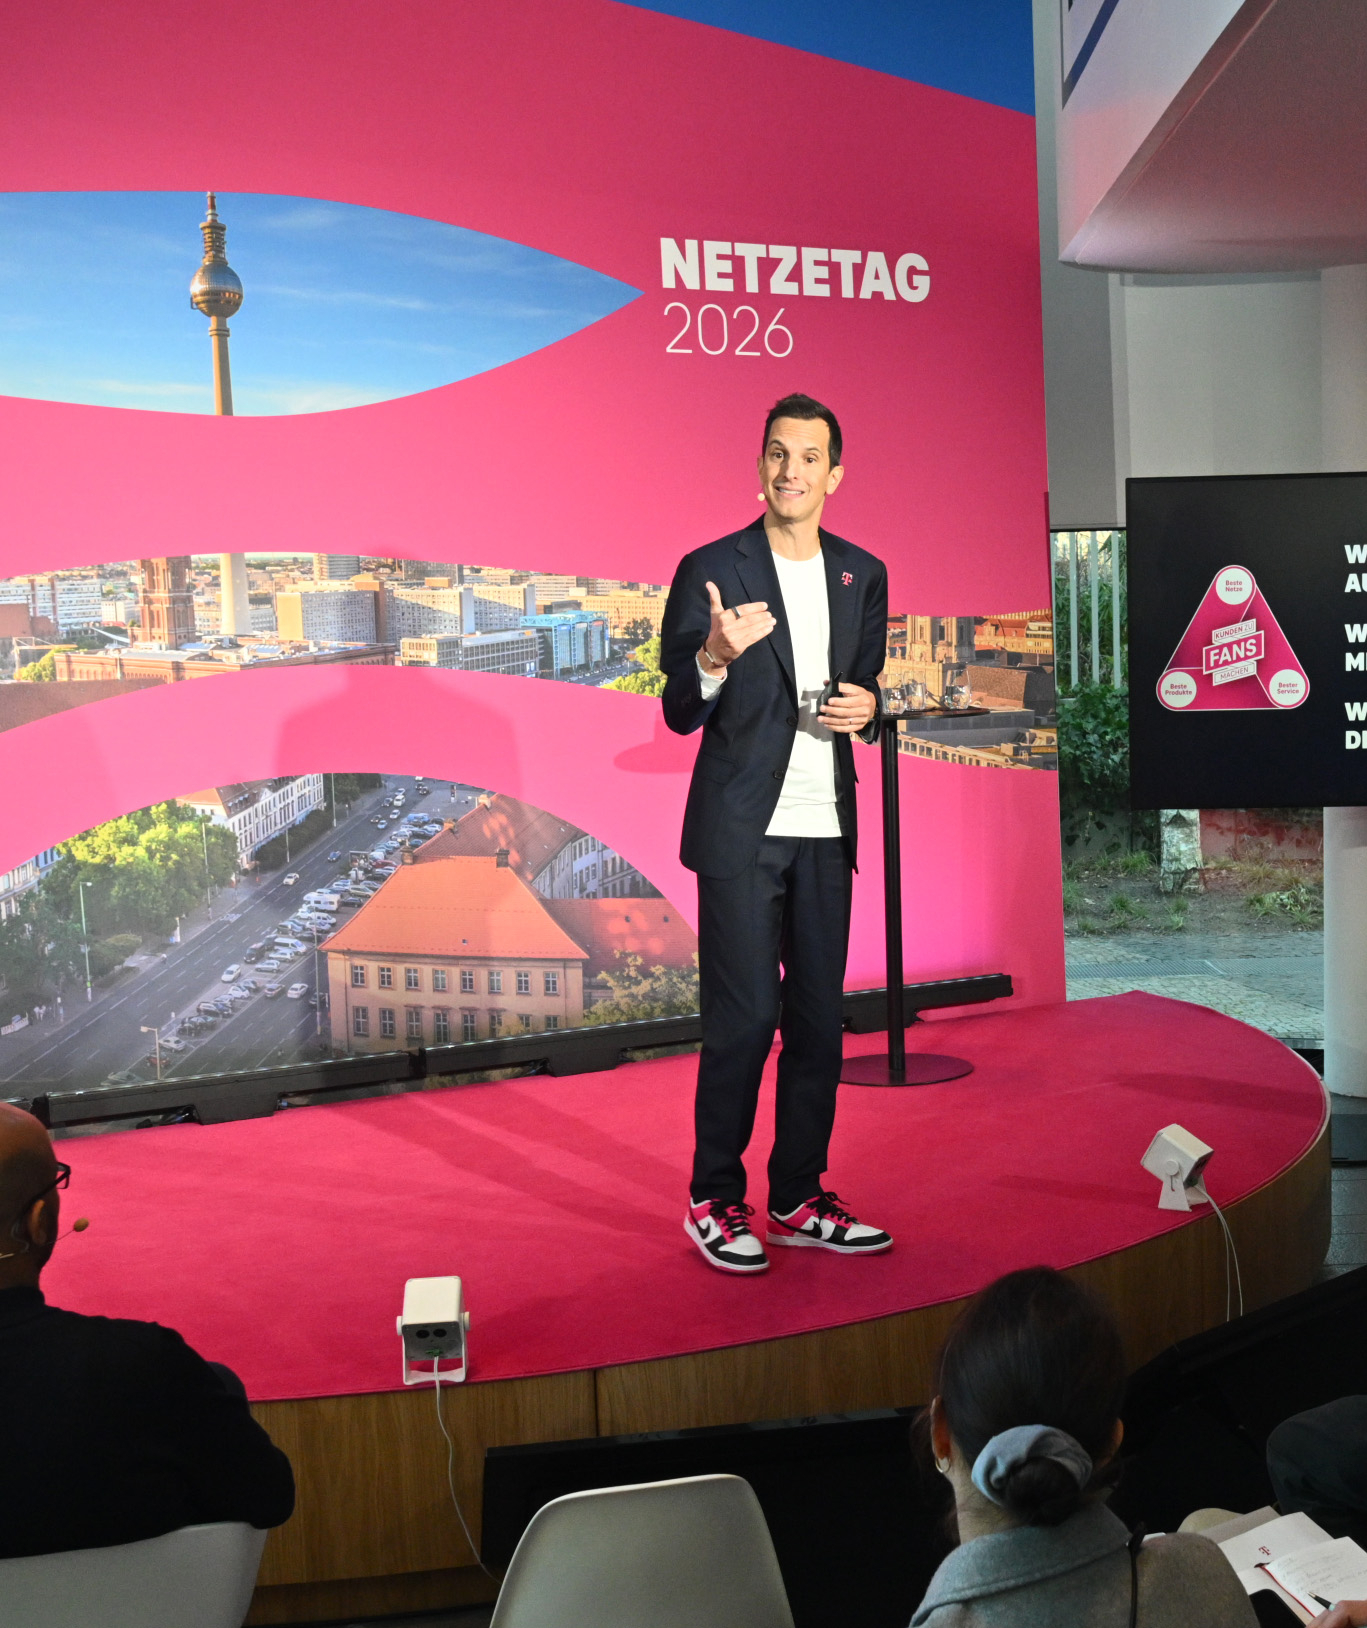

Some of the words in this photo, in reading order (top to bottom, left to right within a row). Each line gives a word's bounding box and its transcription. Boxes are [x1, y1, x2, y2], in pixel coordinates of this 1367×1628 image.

[660, 237, 931, 303] NETZETAG
[663, 302, 794, 358] 2026
[1215, 626, 1243, 640] KUNDEN
[1244, 623, 1253, 631] ZU
[1210, 639, 1256, 667] FANS
[1220, 667, 1249, 680] MACHEN
